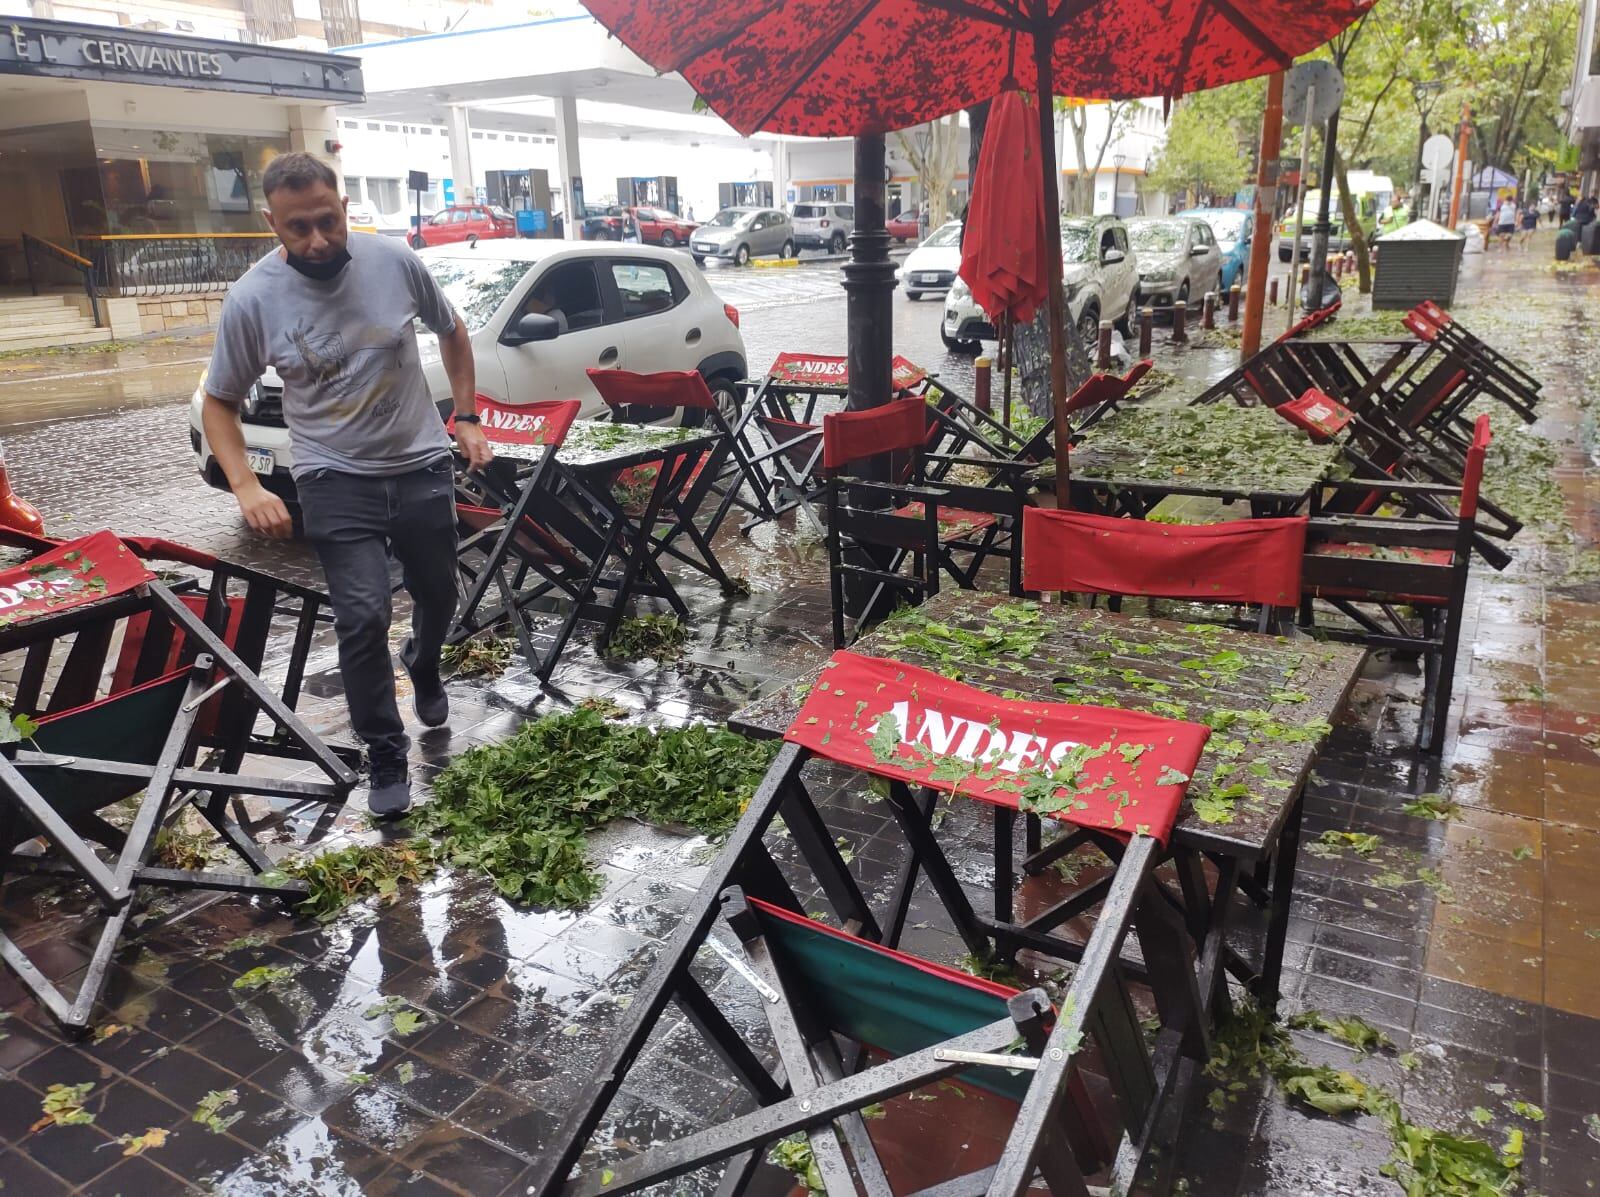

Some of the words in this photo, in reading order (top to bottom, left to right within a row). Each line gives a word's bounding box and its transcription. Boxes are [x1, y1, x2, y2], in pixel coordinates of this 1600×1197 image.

[81, 39, 223, 76] CERVANTES
[789, 360, 846, 375] NDES
[479, 407, 546, 432] ANDES
[257, 456, 271, 473] SR
